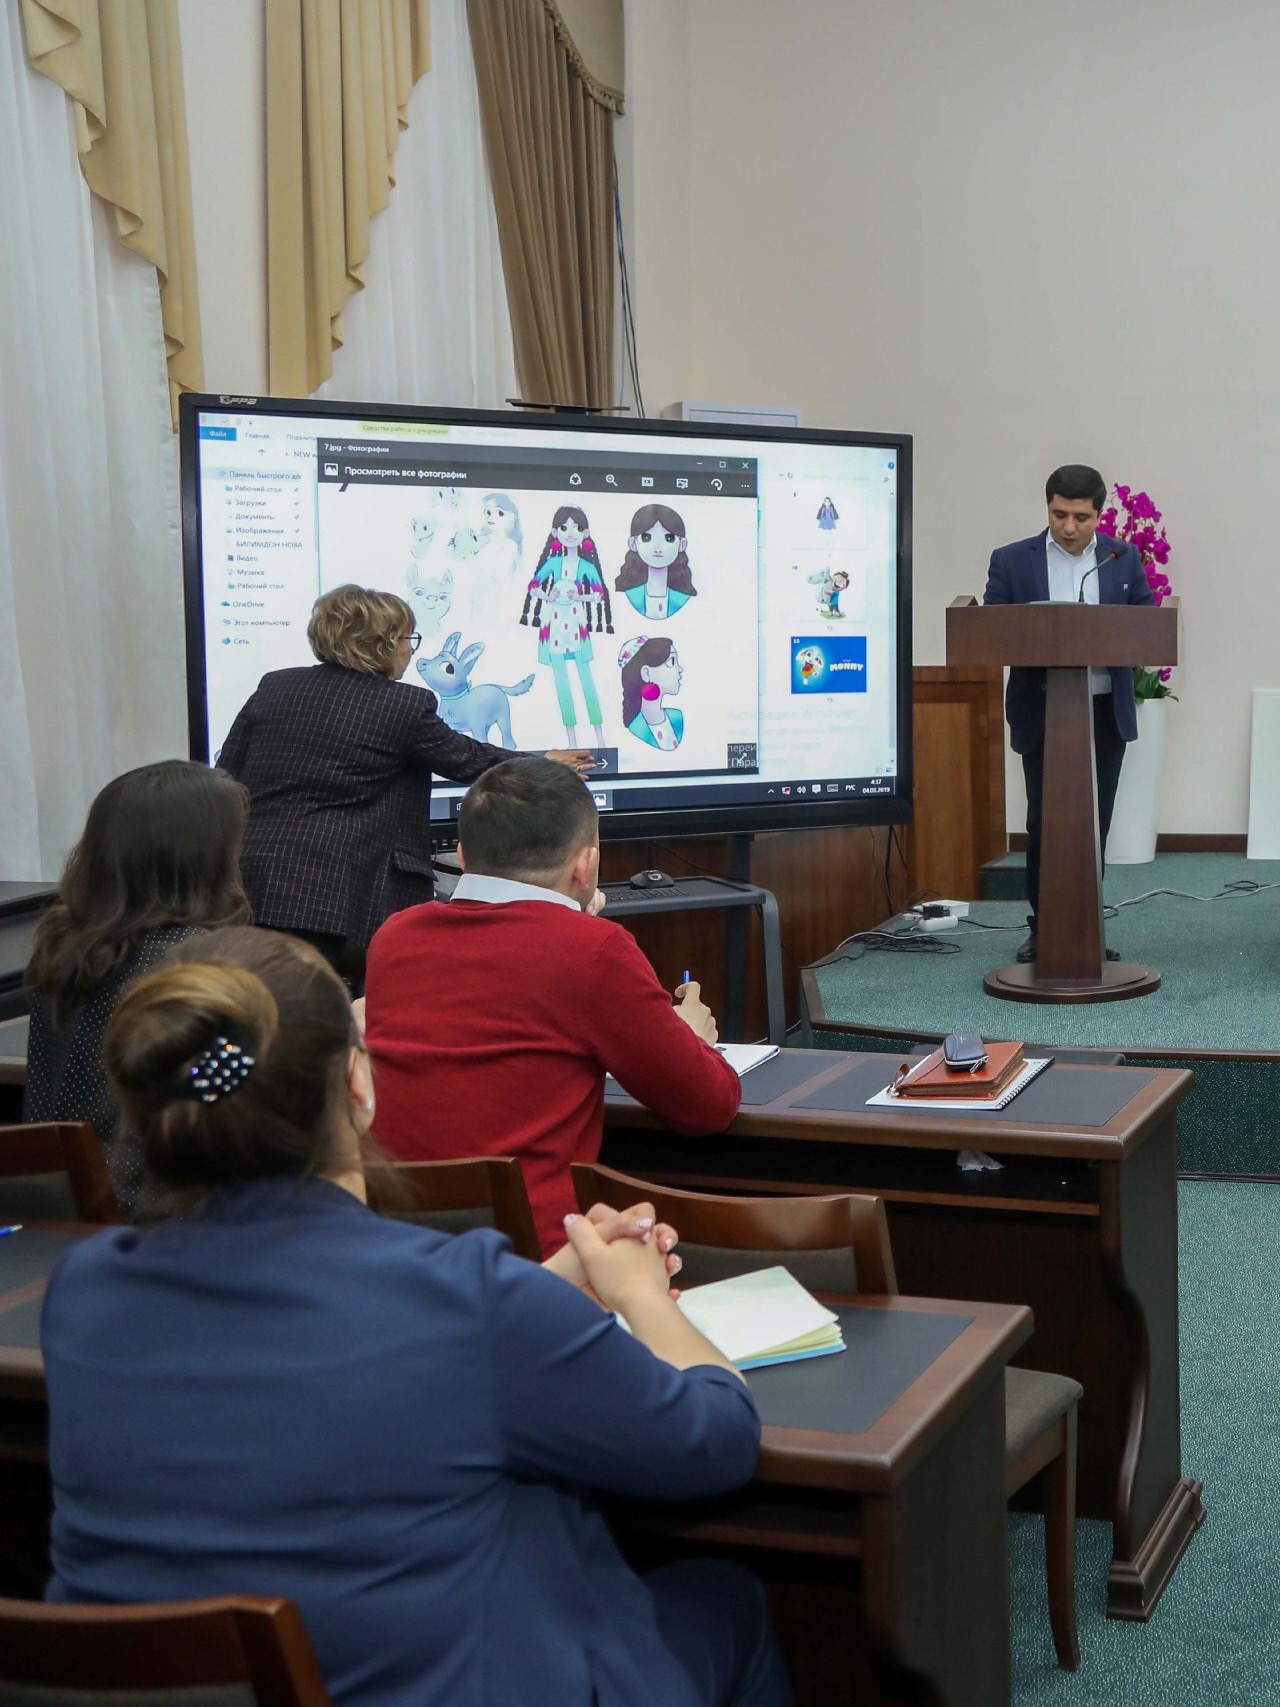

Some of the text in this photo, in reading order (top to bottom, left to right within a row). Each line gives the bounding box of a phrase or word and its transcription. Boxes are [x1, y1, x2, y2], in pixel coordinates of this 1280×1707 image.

[209, 430, 227, 438] Файл
[347, 444, 389, 453] Фотографии
[229, 470, 255, 478] Панель
[256, 471, 290, 480] быстрого
[344, 466, 467, 479] Просмотреть все фотографии
[235, 499, 267, 507] Загрузки
[236, 527, 284, 535] Изображения
[236, 569, 265, 577] Музыка
